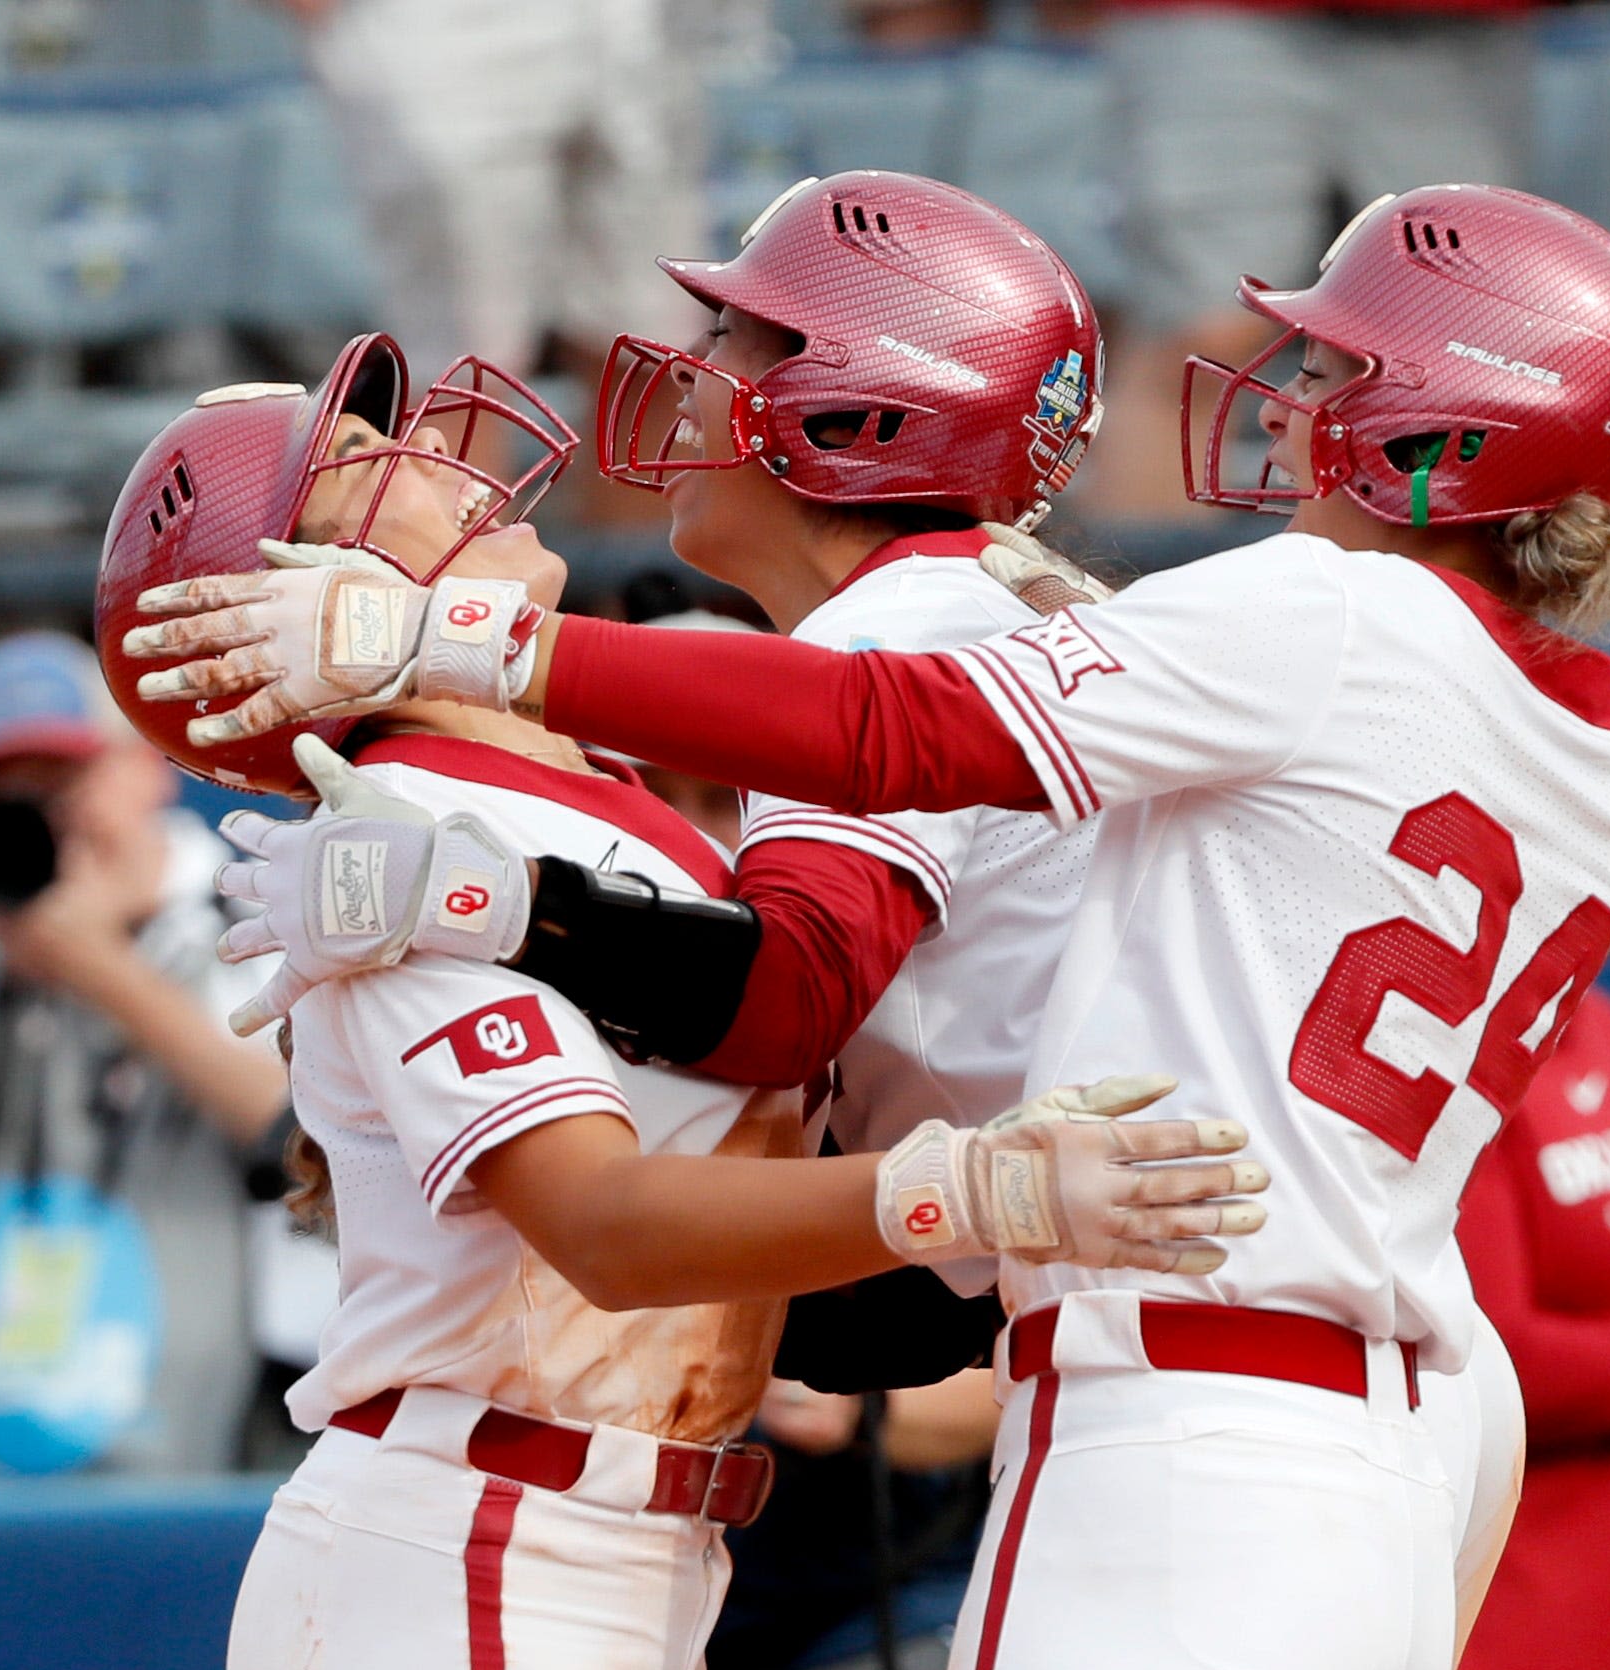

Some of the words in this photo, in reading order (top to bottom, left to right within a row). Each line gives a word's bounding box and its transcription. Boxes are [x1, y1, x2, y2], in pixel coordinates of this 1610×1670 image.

[877, 335, 988, 389] RAWLINGS
[1446, 341, 1563, 386] RAWLINGS
[448, 599, 491, 627] OU
[446, 883, 489, 916] OU
[475, 1012, 529, 1060] OU
[905, 1201, 943, 1234] OU
